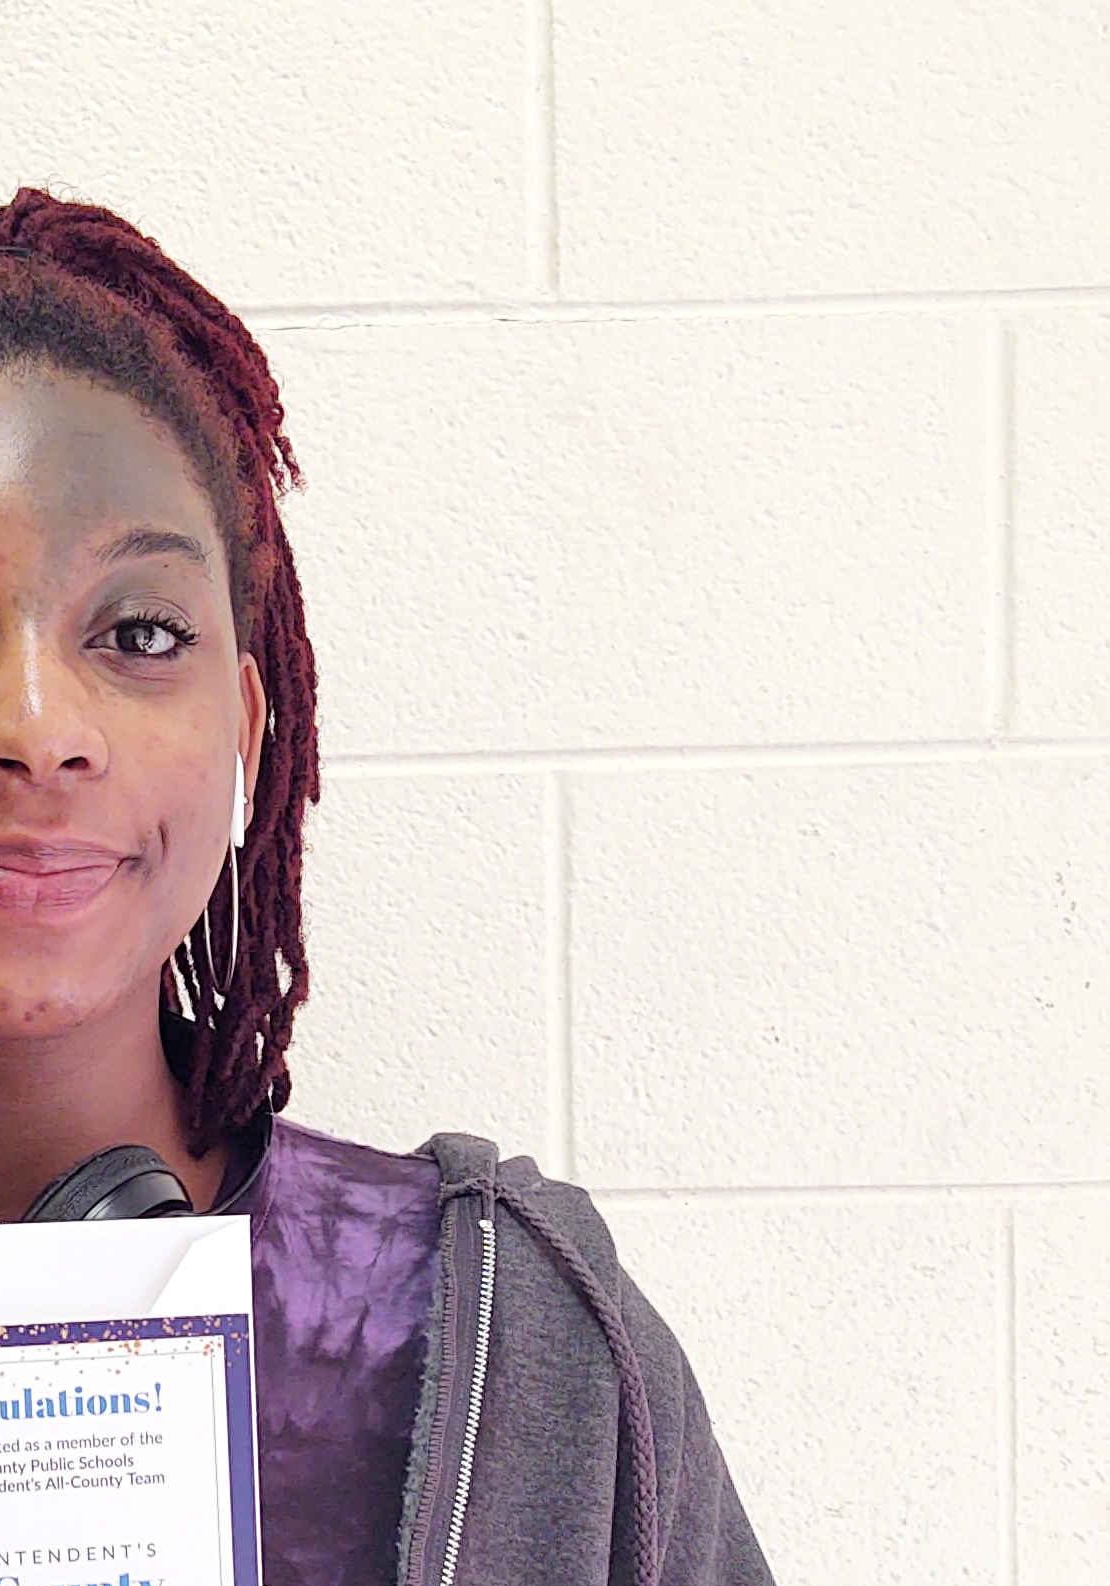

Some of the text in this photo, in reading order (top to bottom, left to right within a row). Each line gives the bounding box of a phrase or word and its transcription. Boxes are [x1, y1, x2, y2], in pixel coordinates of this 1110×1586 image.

[24, 1441, 40, 1452] as
[44, 1440, 52, 1451] a
[56, 1435, 116, 1451] member
[120, 1432, 135, 1447] of
[139, 1431, 163, 1446] the
[31, 1457, 75, 1473] Public
[79, 1454, 134, 1470] Schools
[45, 1474, 123, 1491] All-County
[127, 1472, 165, 1485] Team
